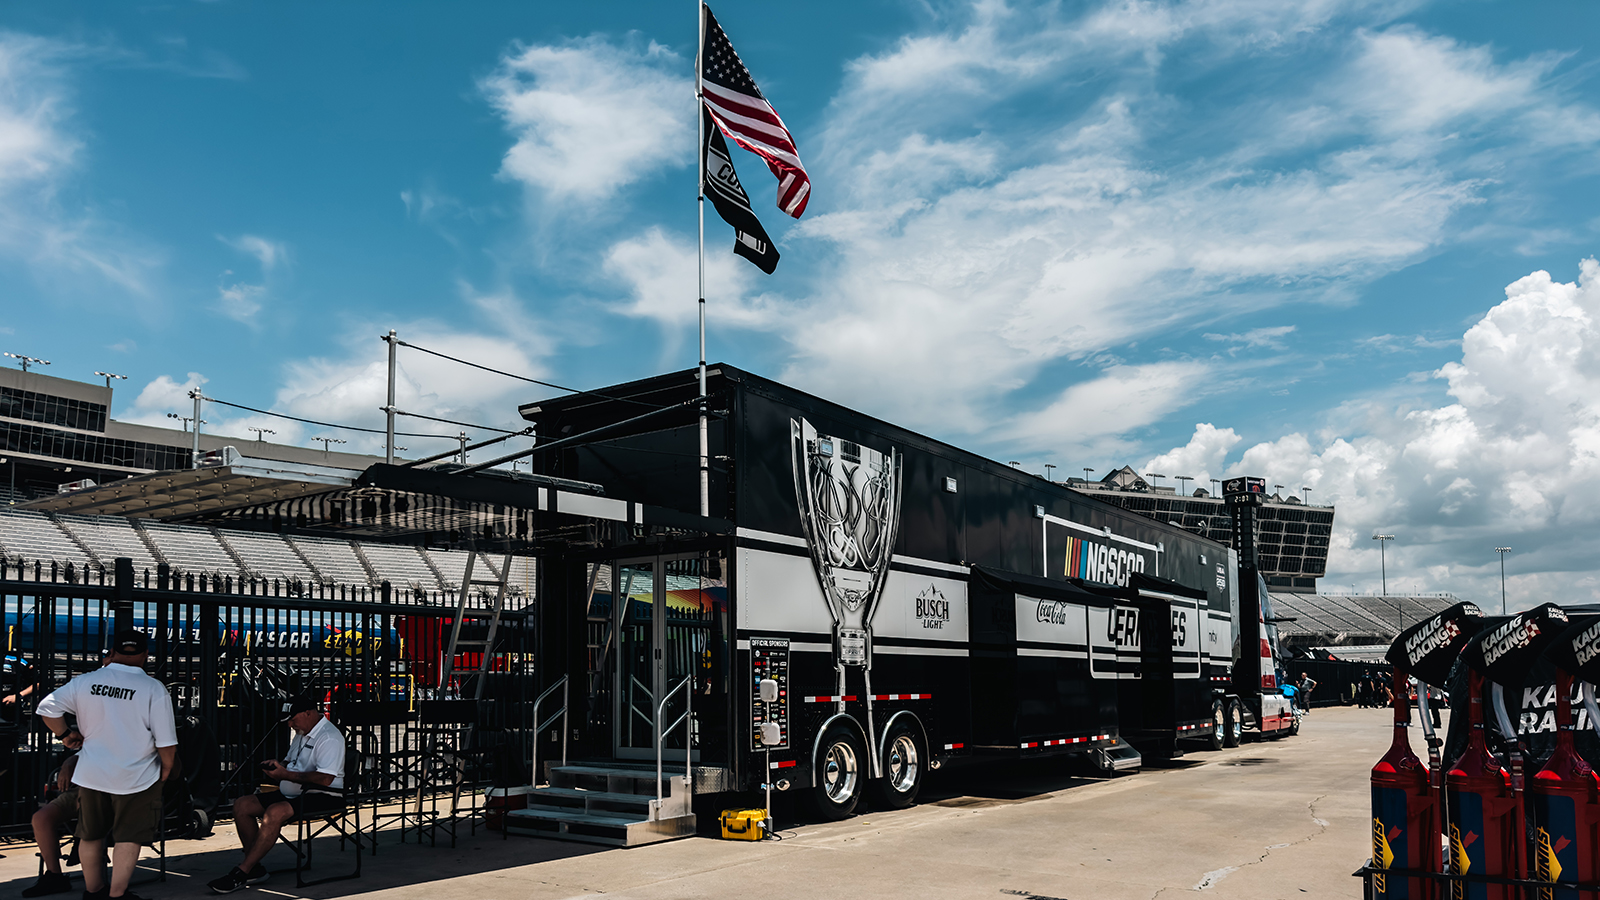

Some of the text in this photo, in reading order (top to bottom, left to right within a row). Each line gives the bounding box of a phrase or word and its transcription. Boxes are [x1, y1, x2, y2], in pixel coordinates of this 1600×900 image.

[915, 598, 949, 619] BUSCH
[923, 619, 943, 629] LIGHT
[1405, 615, 1442, 653] KAULIG
[1481, 615, 1523, 653] KAULIG
[1572, 620, 1600, 653] KAU
[1407, 626, 1449, 667] RACING
[1483, 626, 1527, 667] RACING
[90, 683, 137, 701] SECURITY
[1522, 682, 1600, 709] KAU
[1518, 708, 1594, 735] RAI
